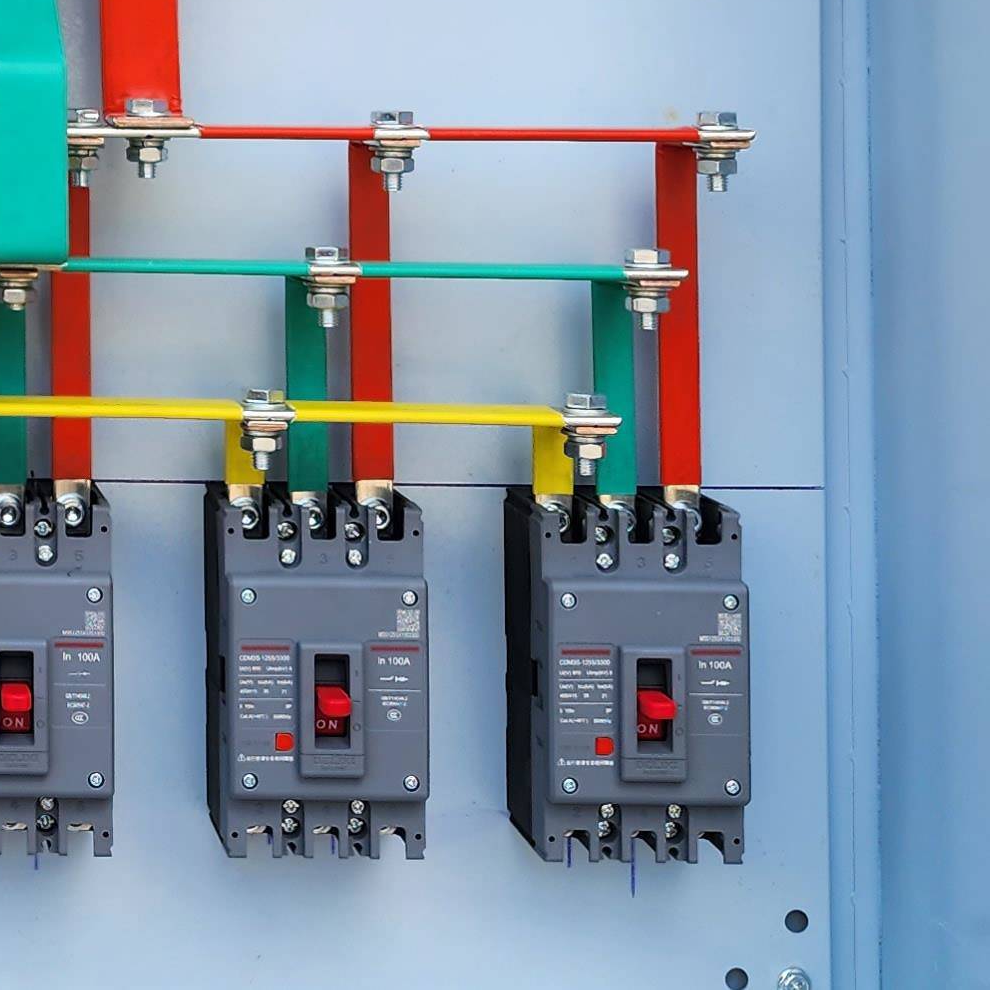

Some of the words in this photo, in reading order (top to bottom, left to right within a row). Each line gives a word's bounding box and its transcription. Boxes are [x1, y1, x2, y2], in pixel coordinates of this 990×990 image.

[62, 651, 71, 661] In
[77, 652, 100, 662] 100A
[378, 657, 385, 665] In
[388, 657, 410, 666] 100A
[698, 661, 707, 669] In
[709, 661, 732, 670] 100A
[2, 717, 24, 728] ON
[316, 719, 338, 729] ON
[636, 723, 659, 734] ON
